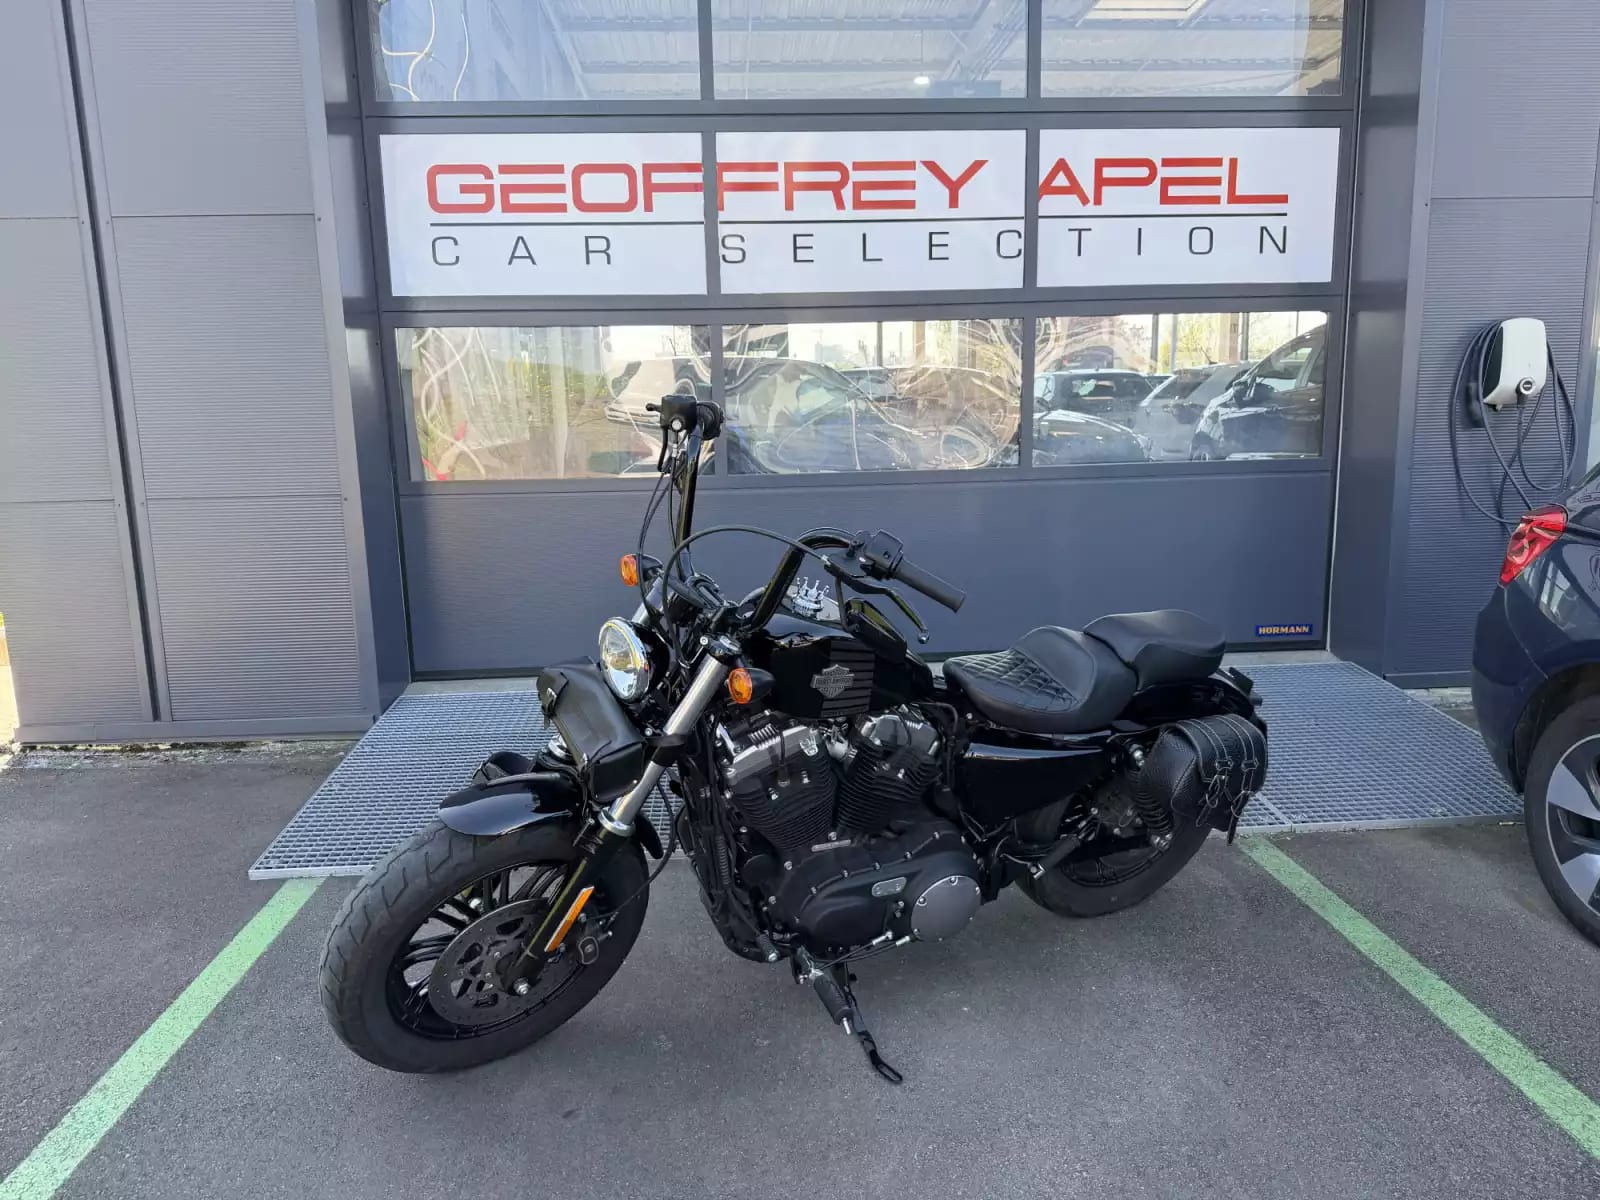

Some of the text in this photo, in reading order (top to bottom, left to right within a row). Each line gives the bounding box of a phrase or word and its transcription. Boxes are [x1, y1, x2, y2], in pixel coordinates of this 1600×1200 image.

[426, 157, 1289, 214] GEOFFREY APEL
[431, 225, 1287, 266] CAR SELECTION
